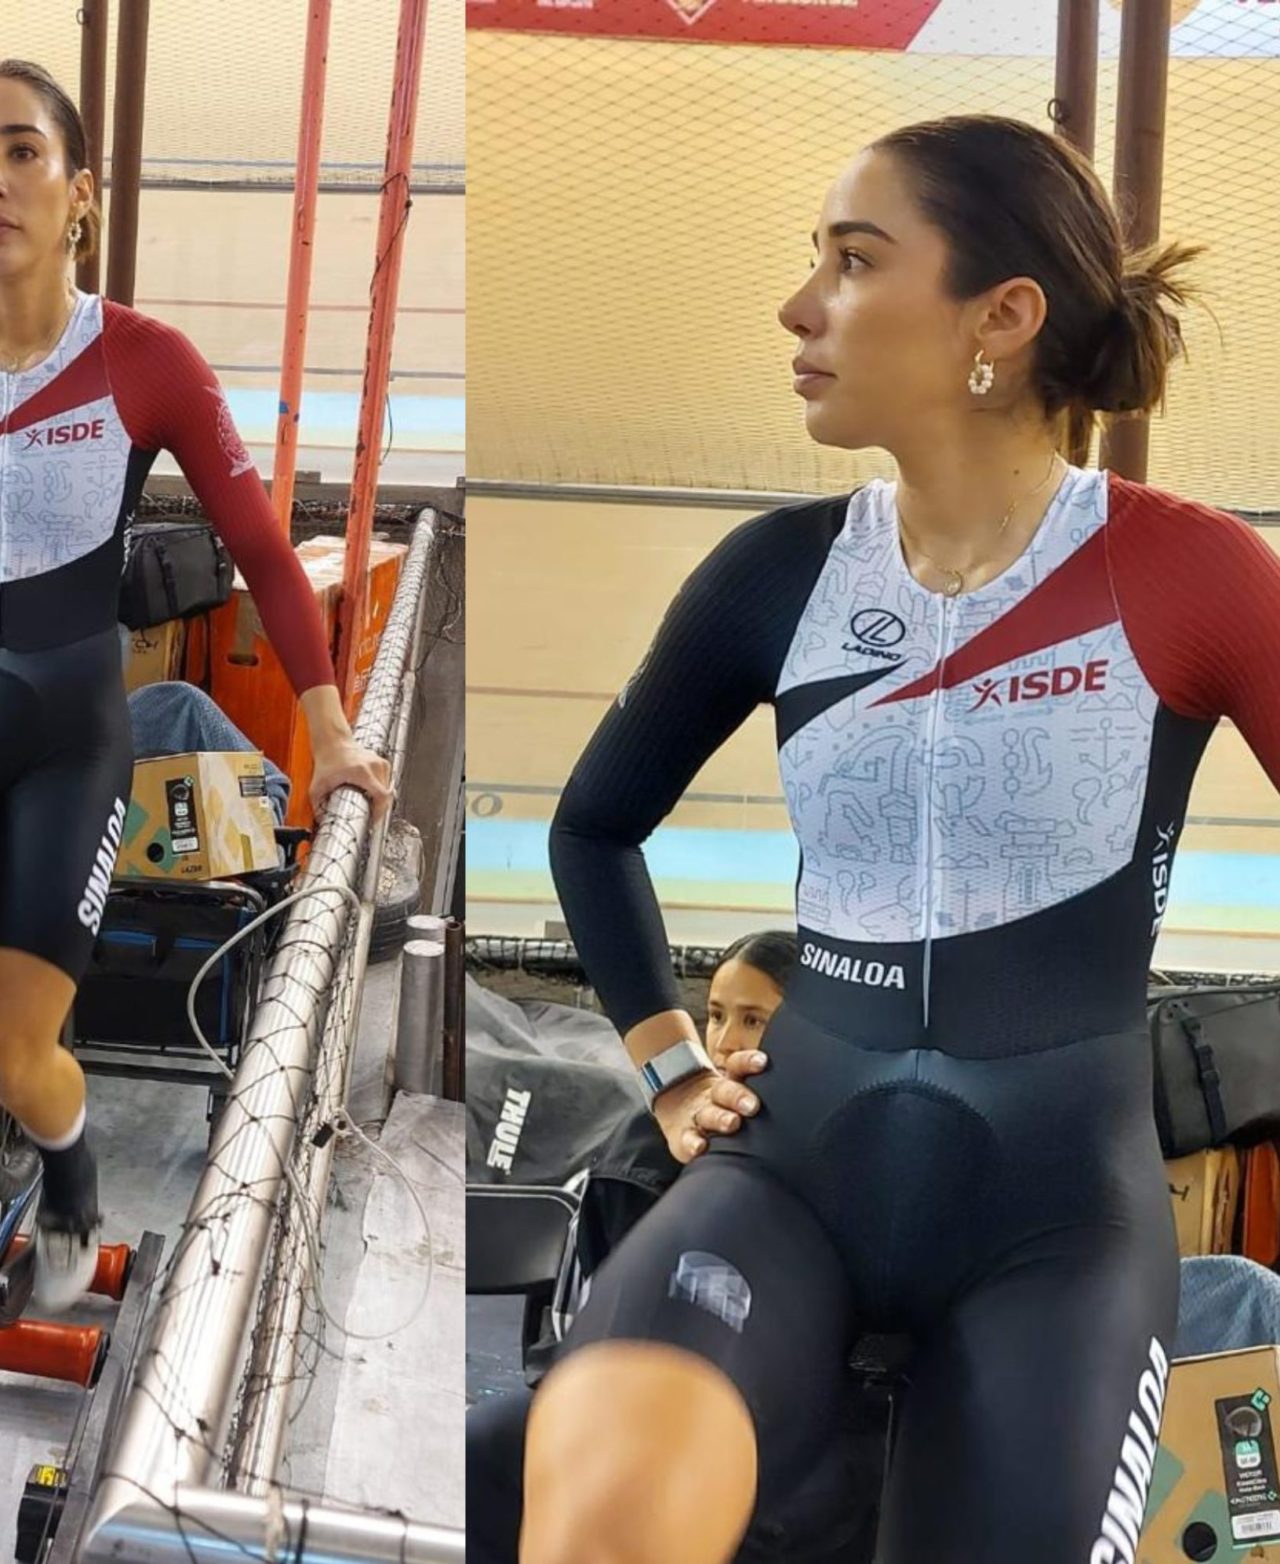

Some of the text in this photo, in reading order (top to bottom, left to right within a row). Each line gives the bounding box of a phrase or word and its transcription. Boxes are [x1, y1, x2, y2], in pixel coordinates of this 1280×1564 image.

[47, 418, 106, 446] ISDE
[841, 642, 902, 662] LADINO
[1008, 658, 1110, 703] ISDE
[800, 943, 906, 990] SINALOA
[486, 1087, 532, 1171] THULE
